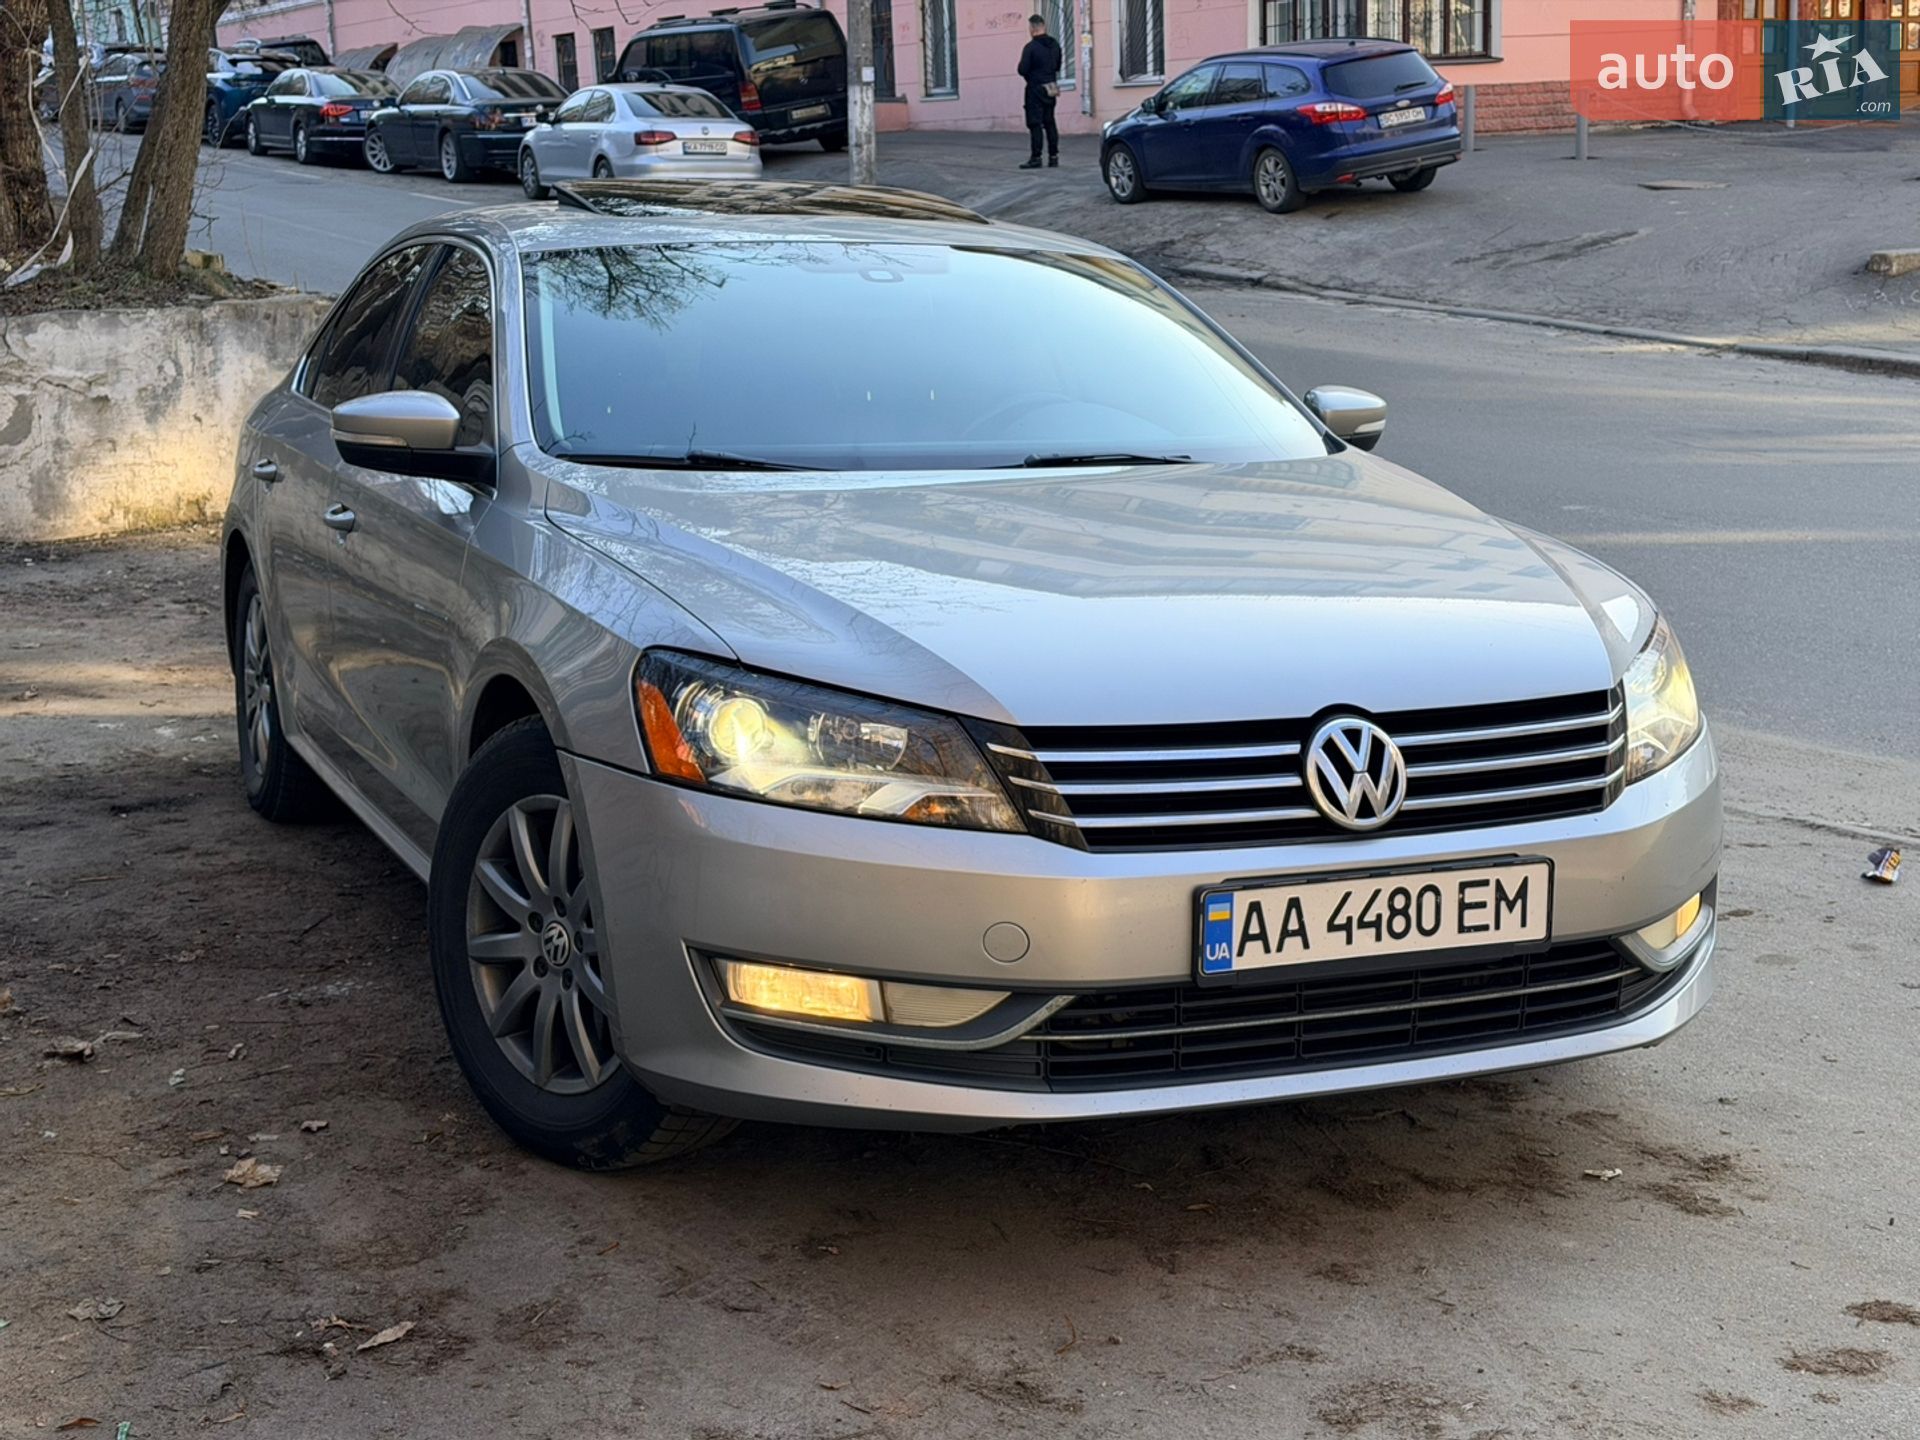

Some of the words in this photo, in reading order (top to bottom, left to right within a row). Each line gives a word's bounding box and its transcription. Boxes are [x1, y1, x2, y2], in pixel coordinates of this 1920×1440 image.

[1236, 896, 1310, 957] AA
[1326, 884, 1442, 945] 4480
[1457, 875, 1529, 934] EM
[1206, 942, 1230, 960] UA
